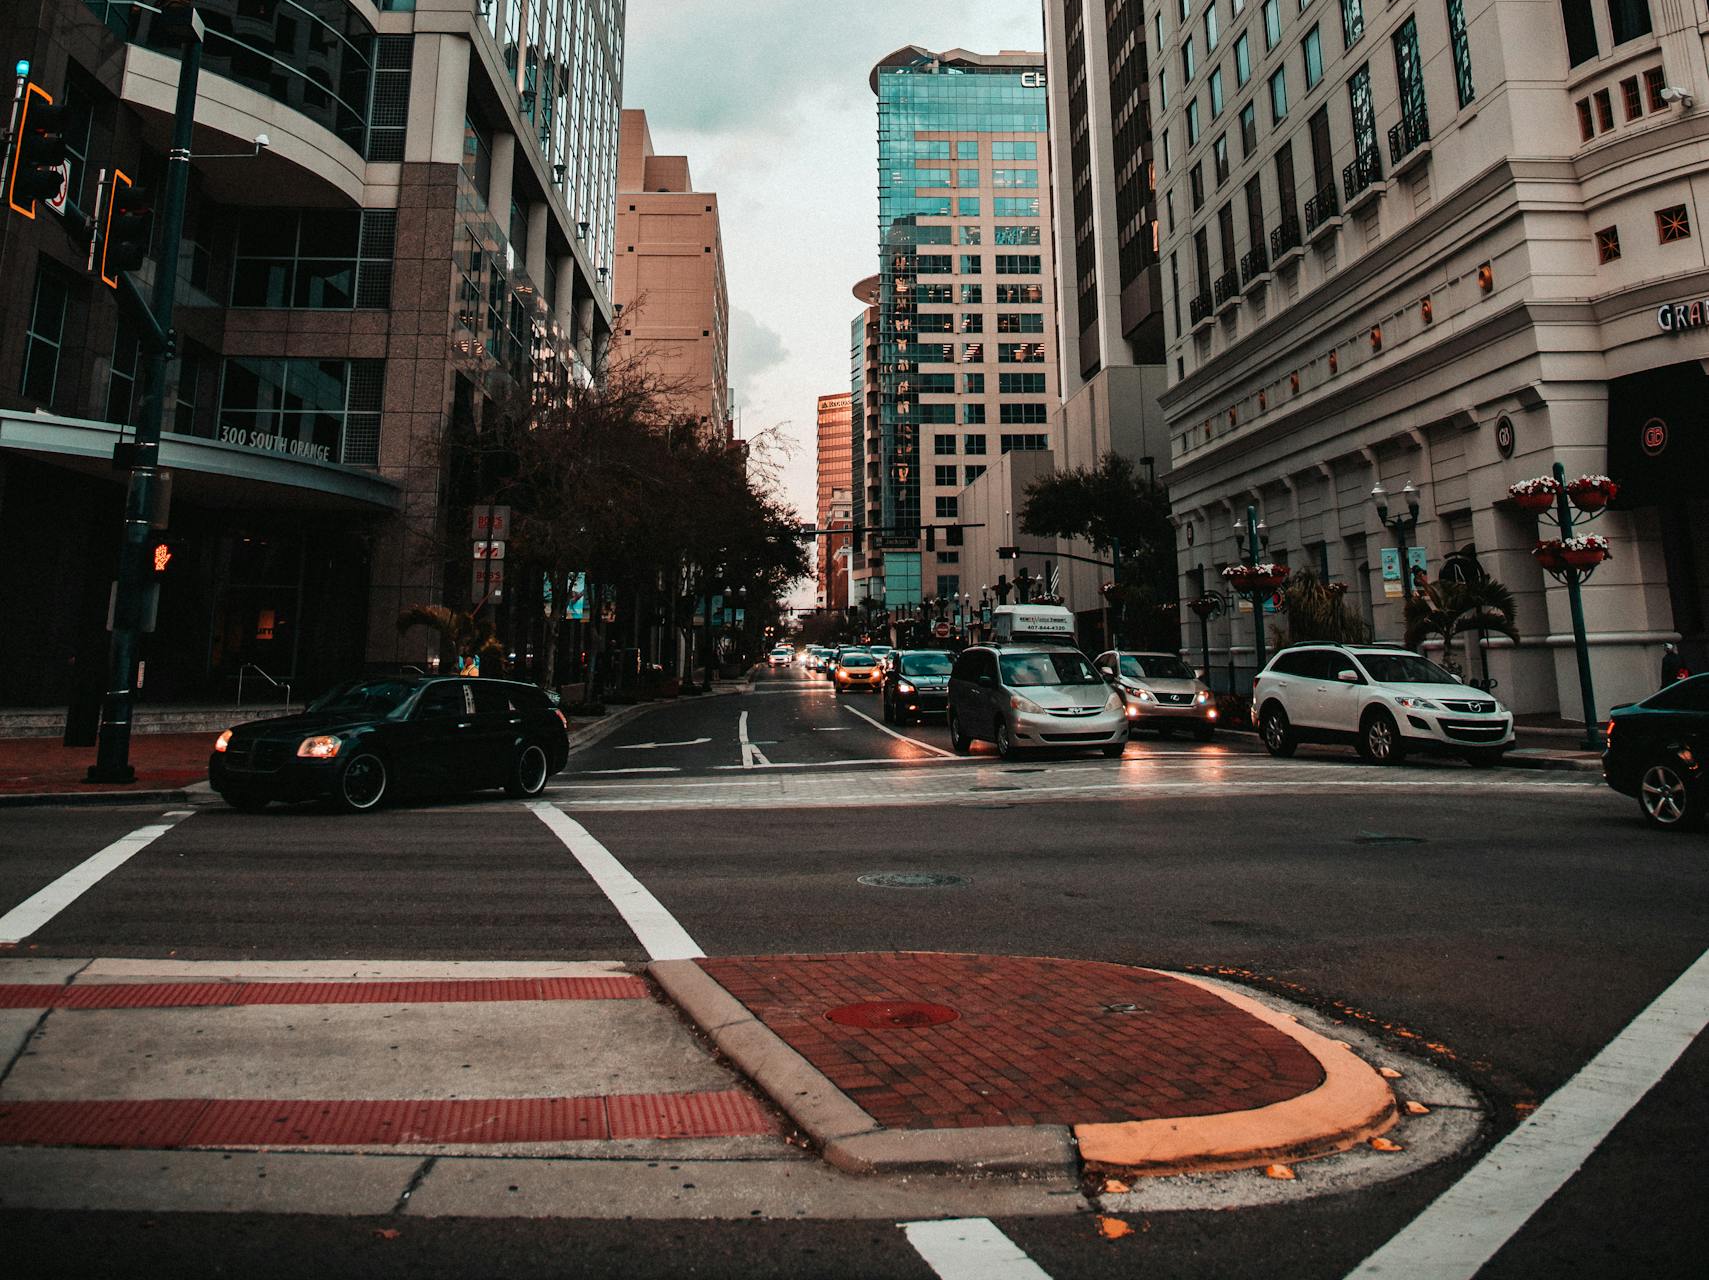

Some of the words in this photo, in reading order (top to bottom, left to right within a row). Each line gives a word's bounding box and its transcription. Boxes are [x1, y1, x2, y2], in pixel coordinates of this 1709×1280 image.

[221, 425, 247, 446] 300
[249, 431, 288, 453] SOUTH
[290, 439, 331, 462] ORANGE
